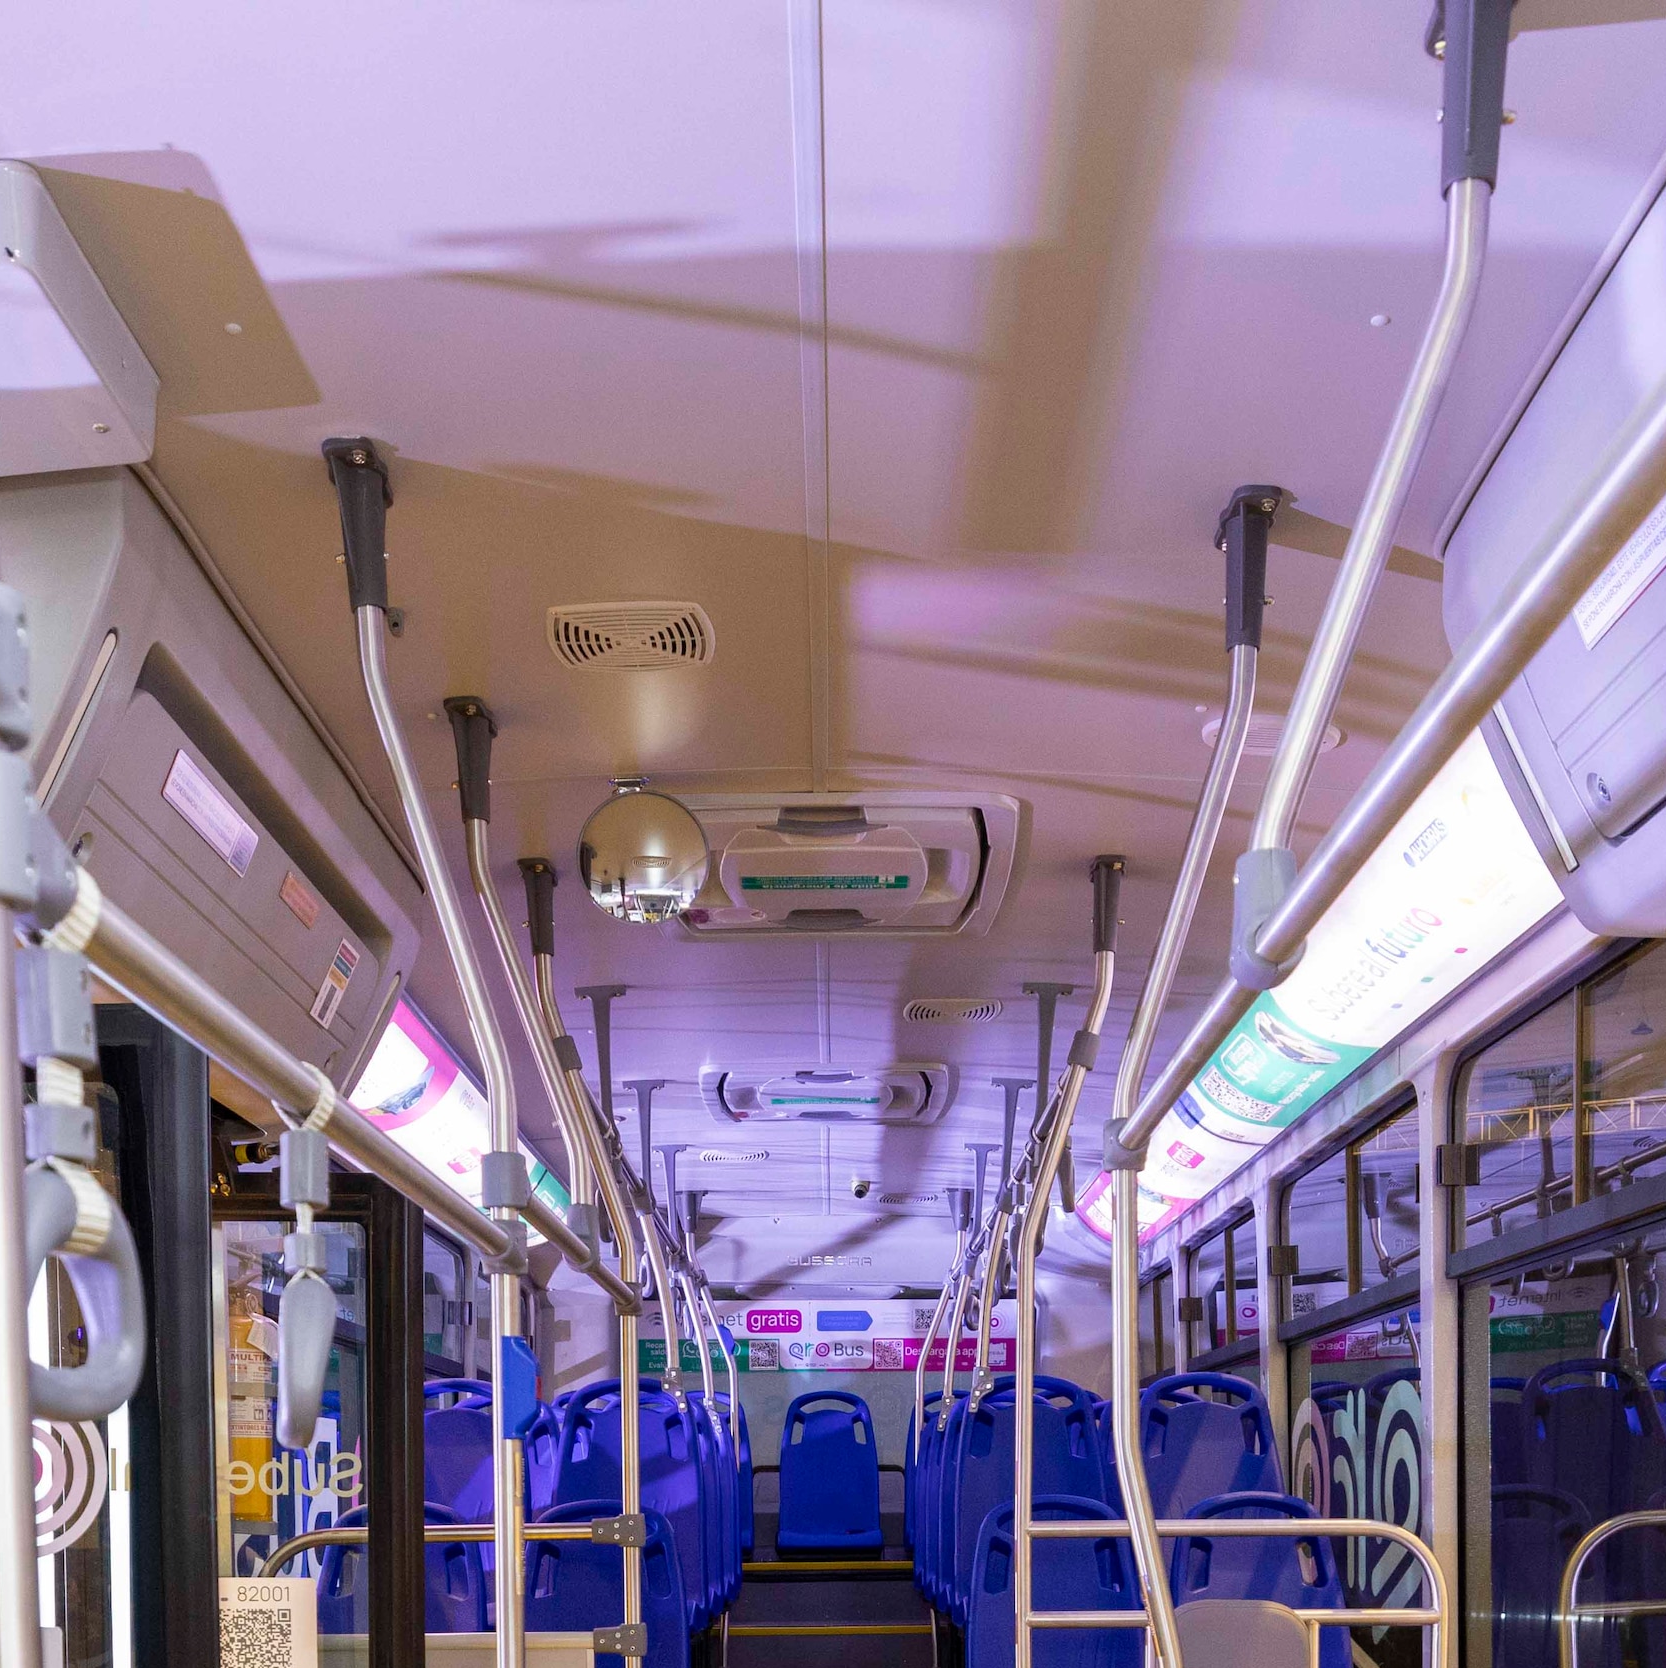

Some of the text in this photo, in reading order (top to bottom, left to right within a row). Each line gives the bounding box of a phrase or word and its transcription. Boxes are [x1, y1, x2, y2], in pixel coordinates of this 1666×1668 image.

[750, 1311, 800, 1331] gratis
[834, 1343, 865, 1357] Bus
[236, 1585, 291, 1603] 82001
